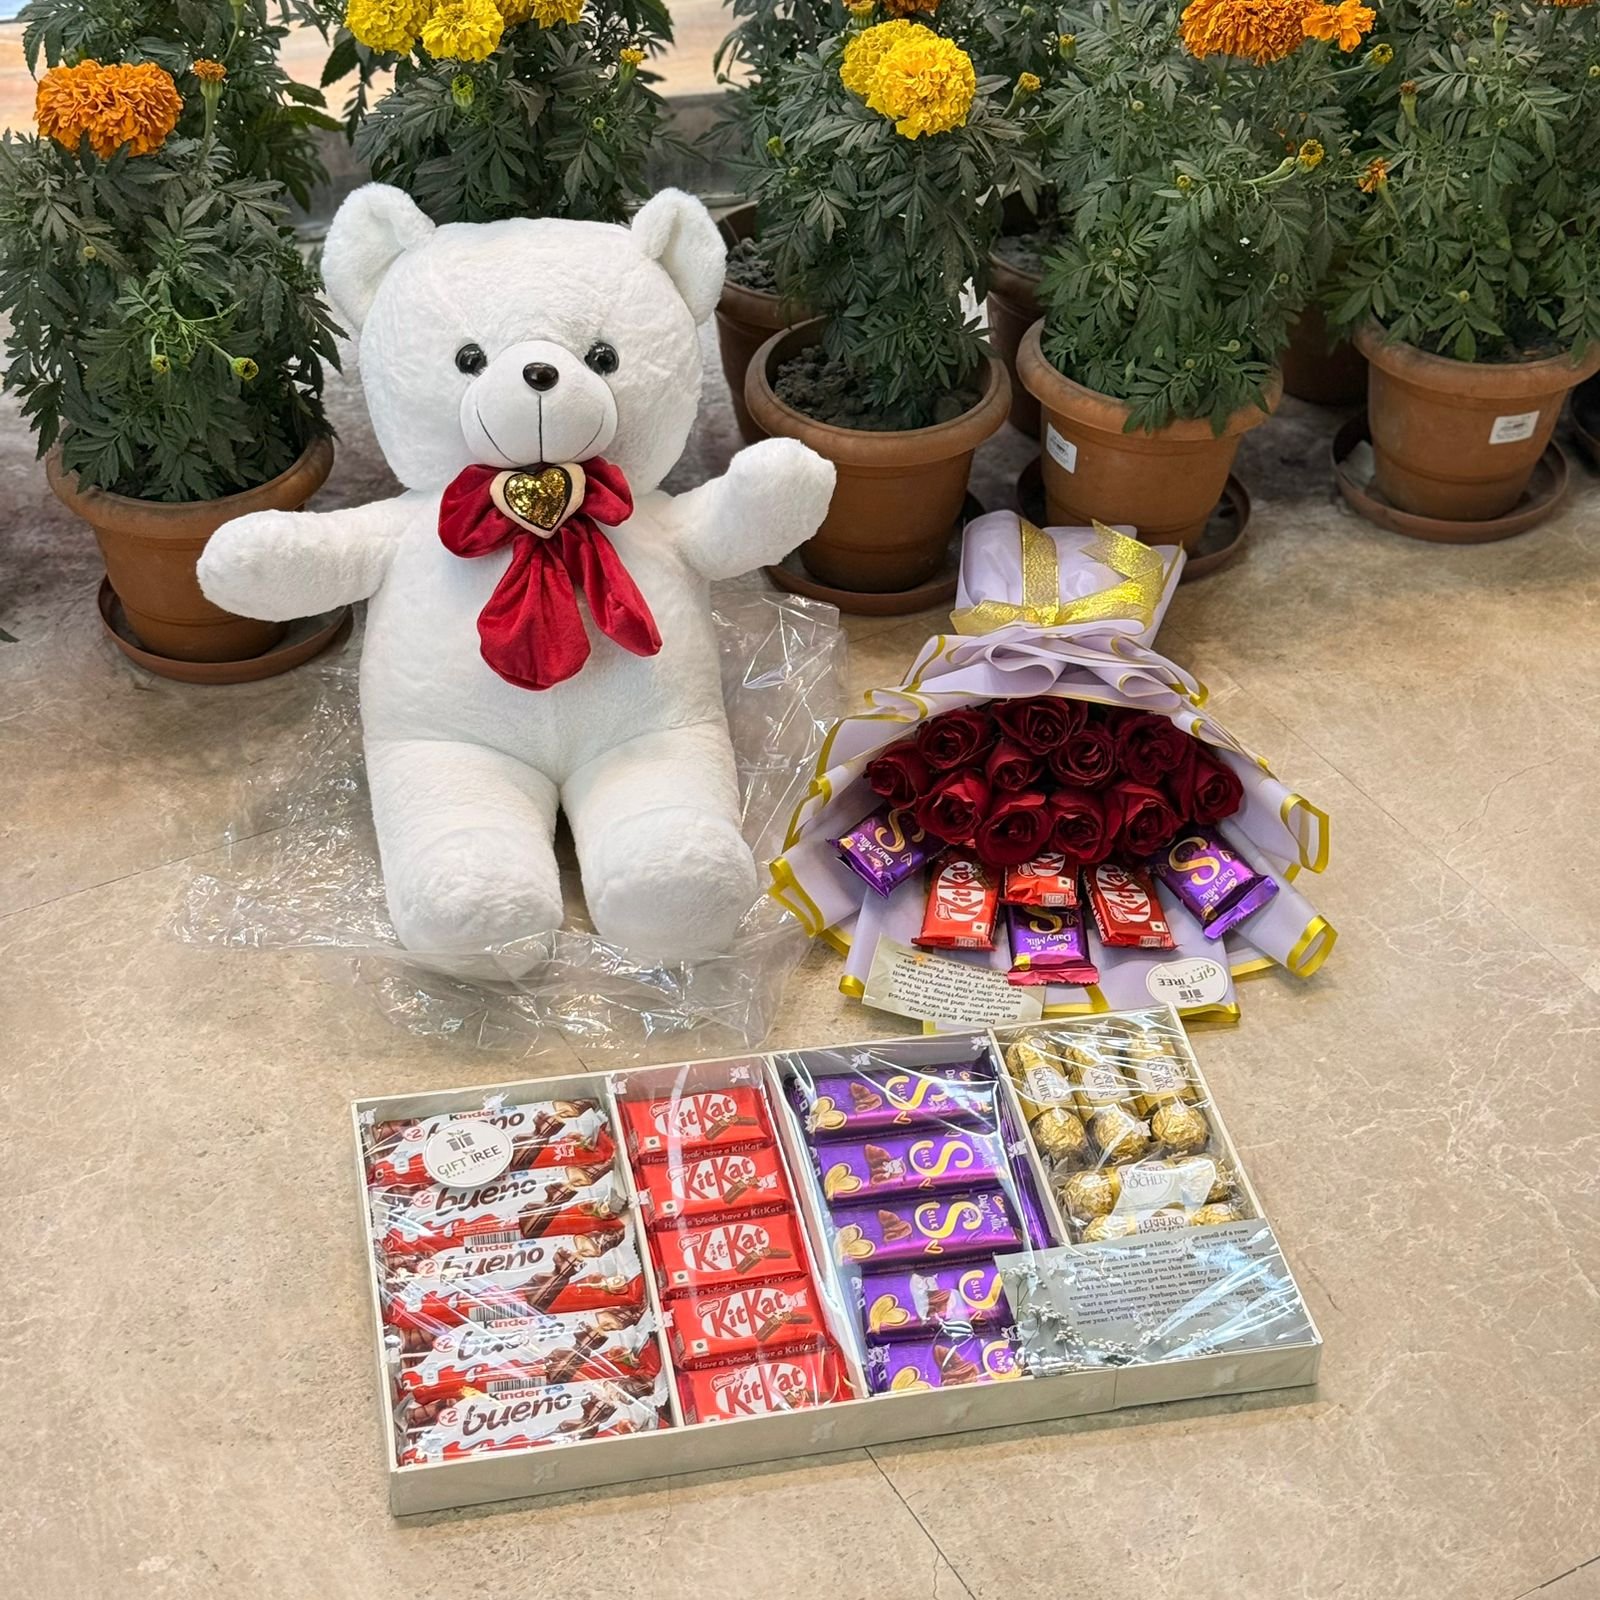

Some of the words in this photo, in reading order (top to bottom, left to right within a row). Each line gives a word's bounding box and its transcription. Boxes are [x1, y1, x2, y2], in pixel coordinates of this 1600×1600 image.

[856, 833, 876, 851] Milk
[872, 845, 896, 866] Dairy
[1213, 868, 1236, 887] Dairy
[939, 862, 984, 916] KitKat
[1026, 937, 1045, 945] Milk
[1047, 934, 1071, 942] Dairy
[896, 964, 916, 972] when
[918, 970, 933, 978] bad
[919, 963, 944, 973] Please
[948, 962, 966, 970] Take
[1190, 964, 1216, 984] GIFT
[908, 974, 951, 988] everything
[914, 984, 929, 992] I'm
[888, 992, 920, 1004] worried
[922, 994, 948, 1003] please
[996, 996, 1021, 1004] worry
[449, 1108, 496, 1122] Kinder
[662, 1095, 734, 1135] KitKat
[437, 1158, 467, 1176] GIFT
[920, 1149, 932, 1168] SILK
[683, 1157, 751, 1200] KitKat
[1123, 1173, 1168, 1189] ROCHER
[436, 1178, 536, 1216] bueno
[926, 1209, 938, 1229] SILK
[464, 1242, 514, 1254] Kinder
[692, 1225, 767, 1271] KitKat
[970, 1279, 984, 1300] SILK
[708, 1289, 787, 1338] KitKat
[489, 1387, 542, 1401] Kinder
[724, 1364, 805, 1414] KitKat
[462, 1391, 573, 1436] bueno
